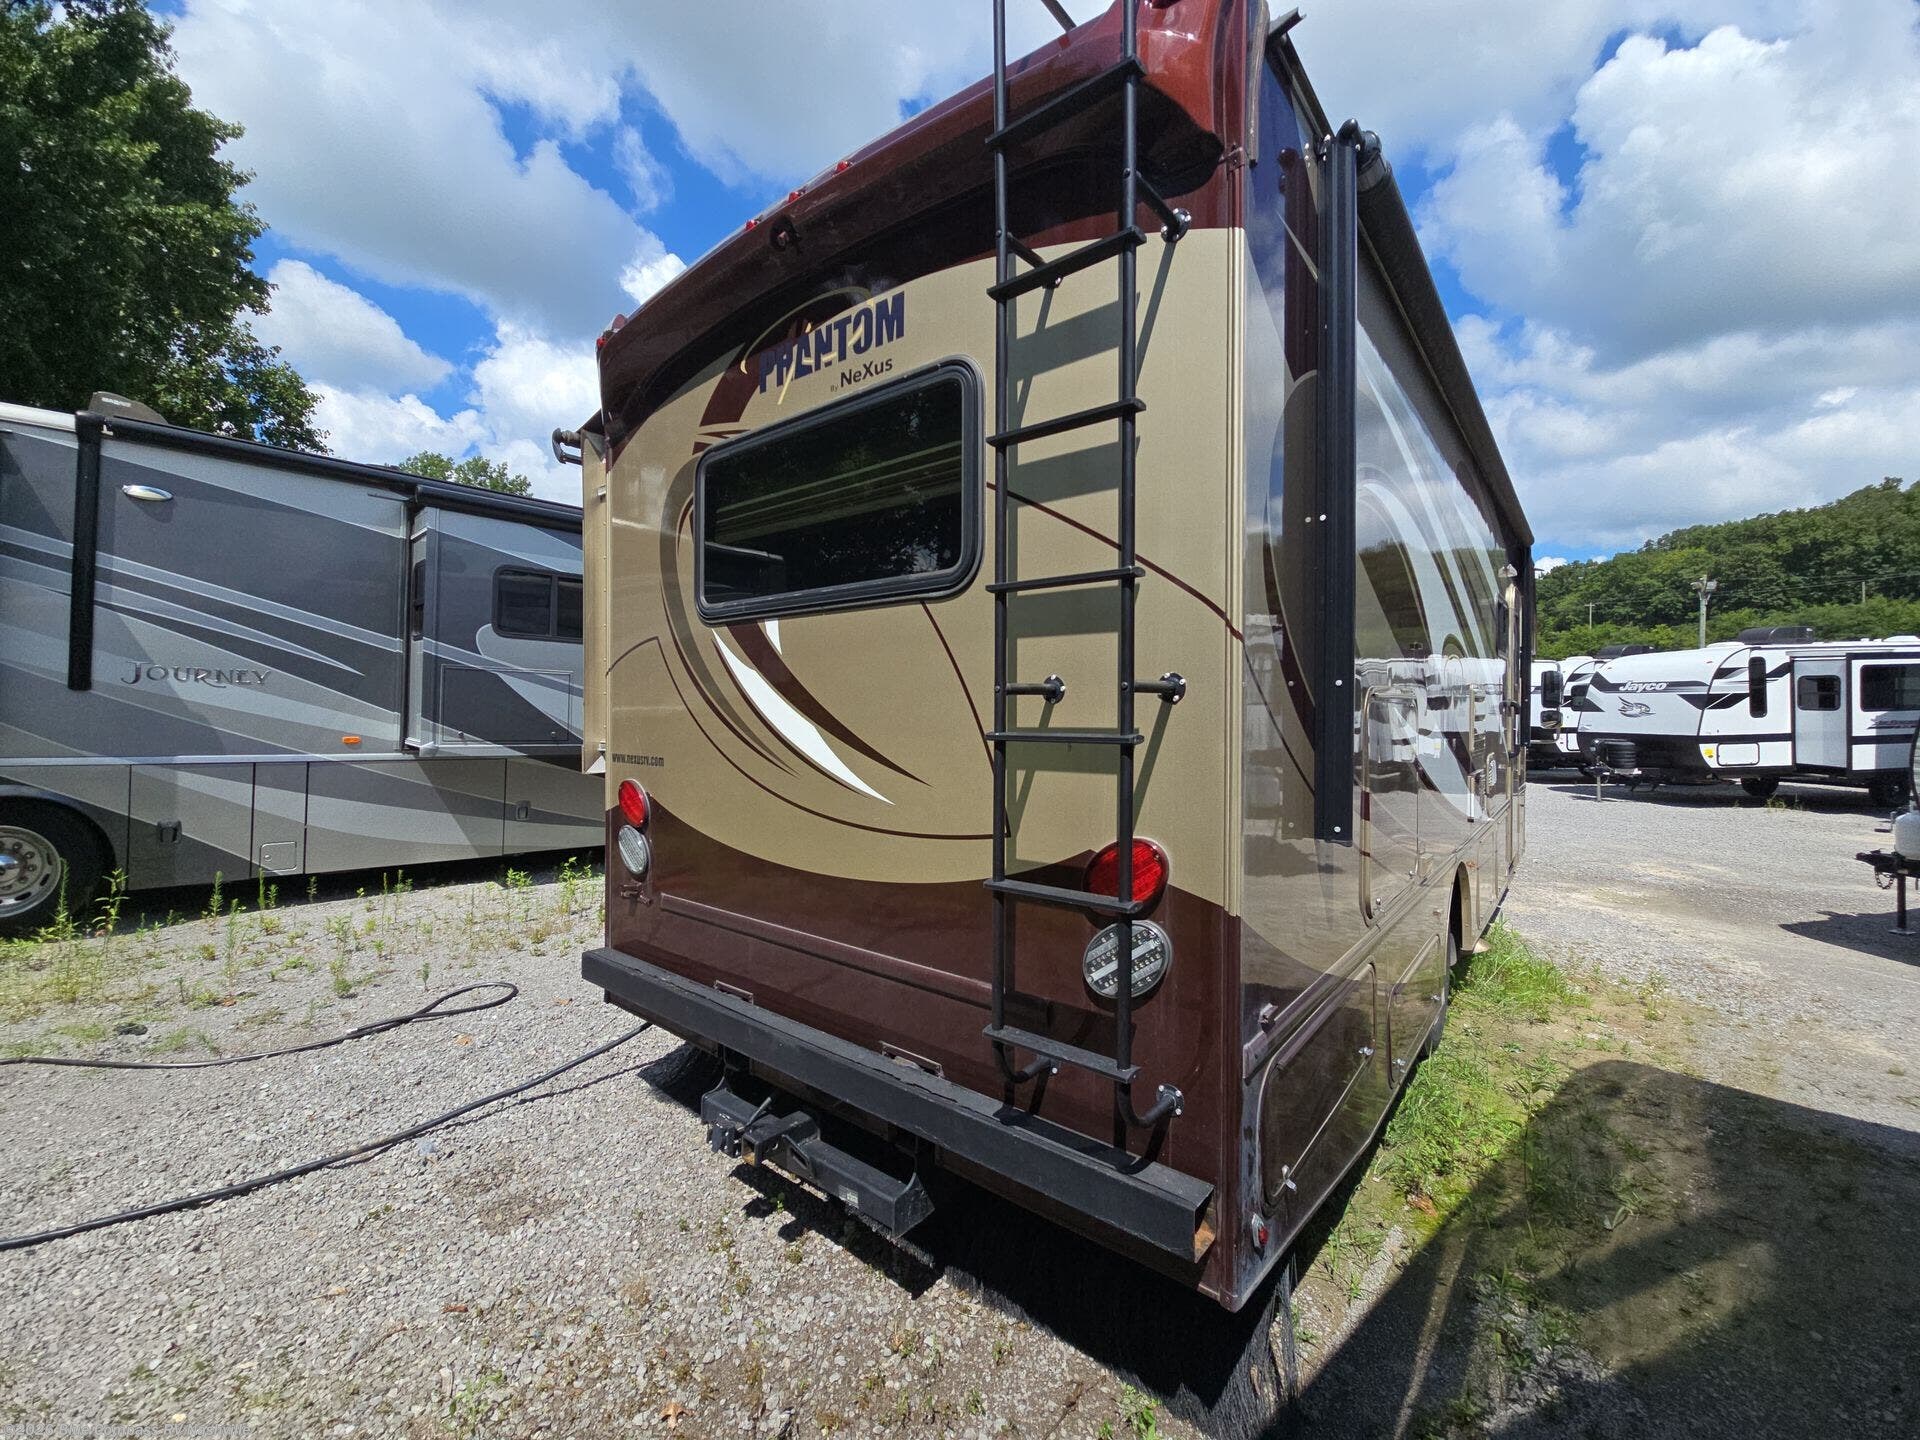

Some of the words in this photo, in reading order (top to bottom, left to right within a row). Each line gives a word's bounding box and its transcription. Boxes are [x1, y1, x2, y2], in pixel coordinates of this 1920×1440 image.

[759, 291, 905, 394] PHANTOM
[840, 358, 893, 388] NeXus
[121, 660, 271, 688] JOURNEY
[1619, 680, 1668, 693] Jayco
[611, 753, 665, 767] www.nexusrv.com
